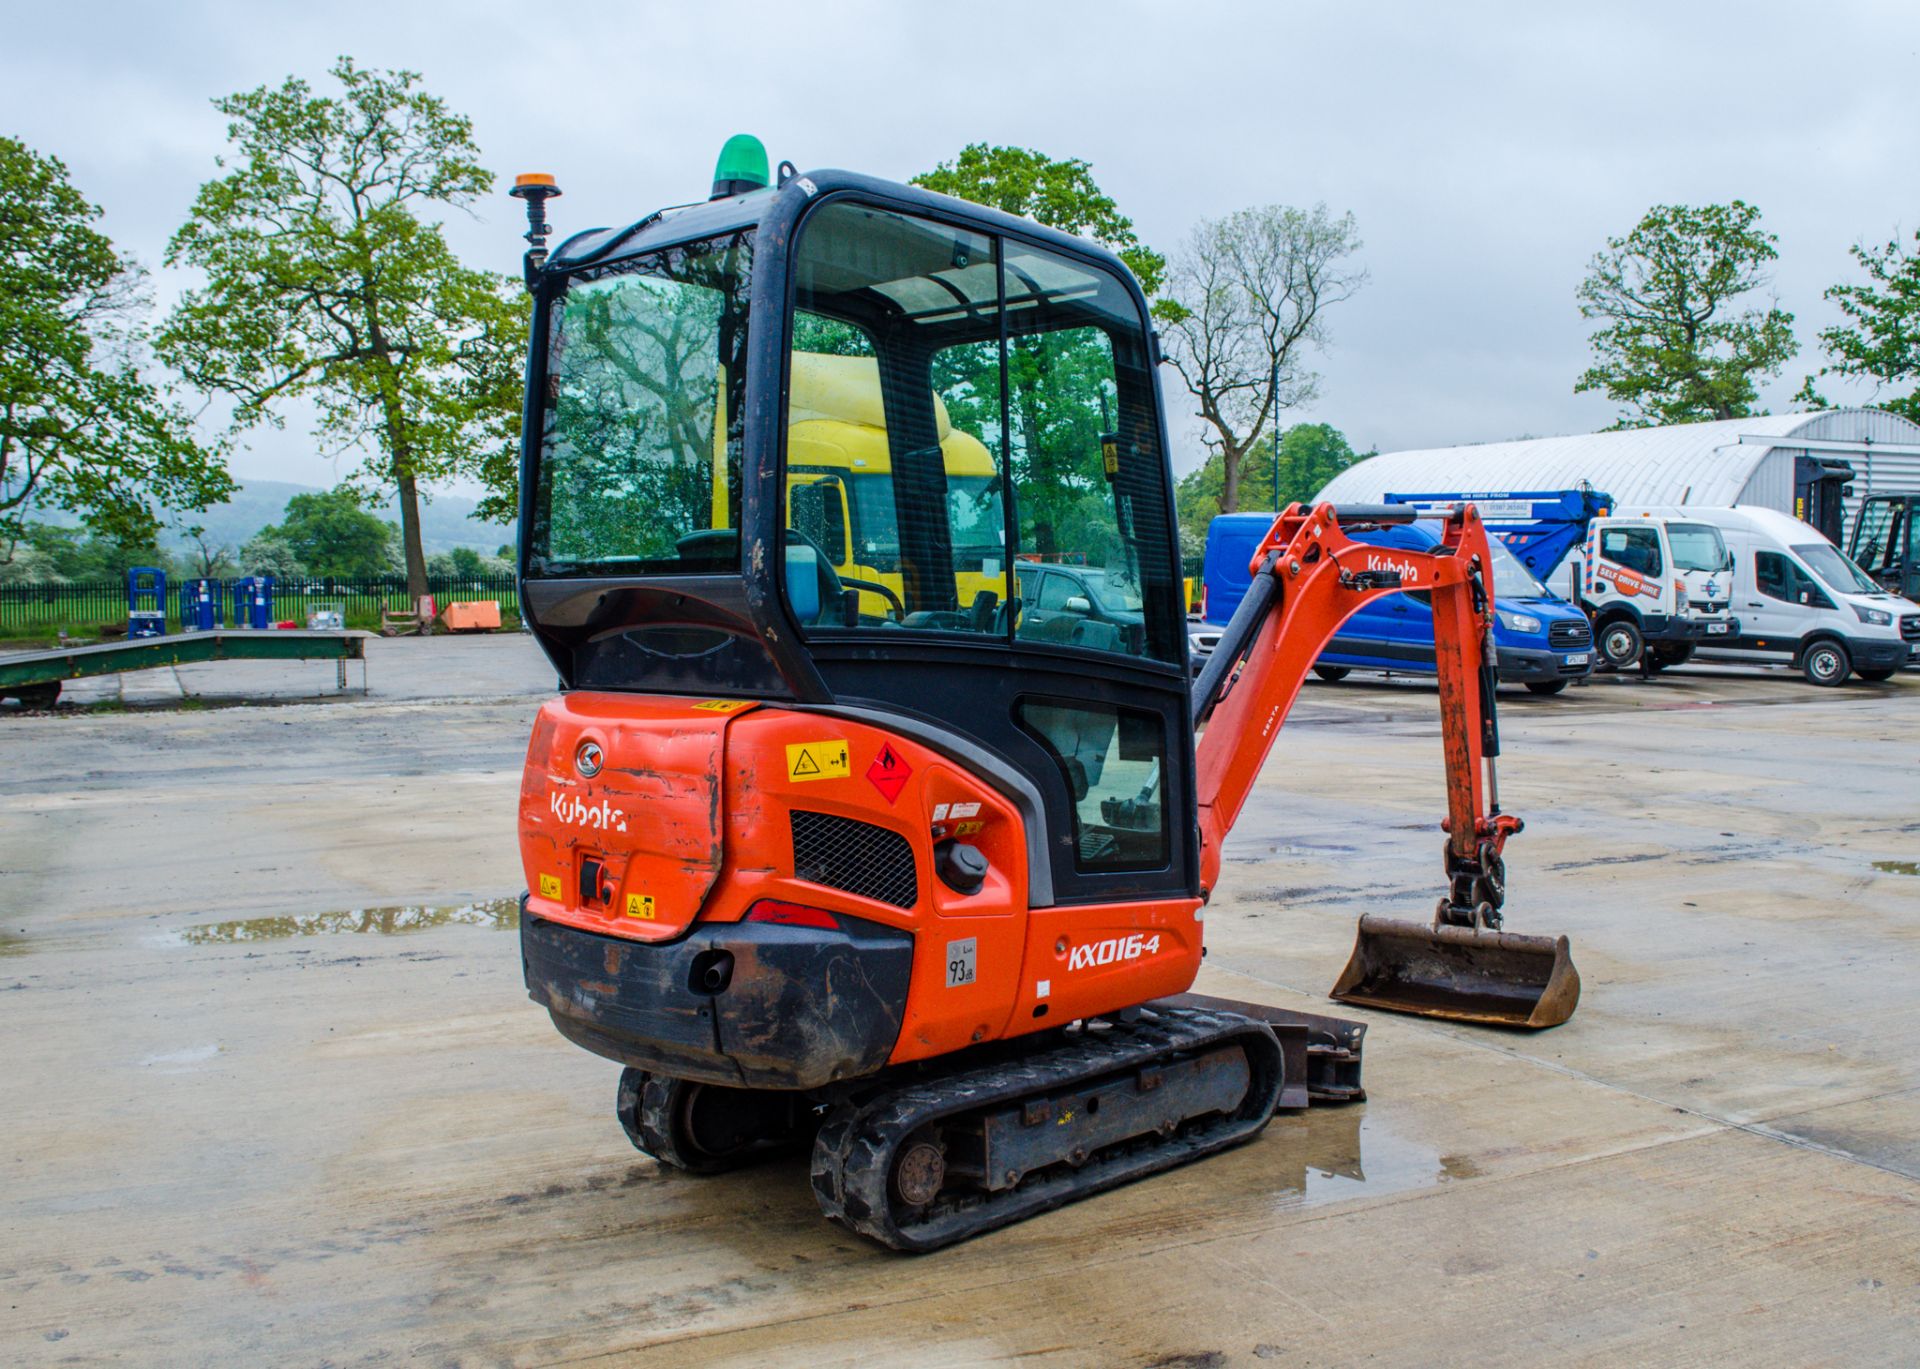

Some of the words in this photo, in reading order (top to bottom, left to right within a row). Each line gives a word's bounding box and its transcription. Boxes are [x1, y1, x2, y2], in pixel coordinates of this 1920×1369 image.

[1367, 554, 1418, 582] Kubota
[1599, 567, 1618, 580] SELF
[1617, 574, 1640, 589] DRIVE
[1640, 583, 1659, 597] HIRE
[551, 791, 627, 832] Kubota
[1067, 933, 1160, 971] KX016-4
[949, 959, 965, 983] 93
